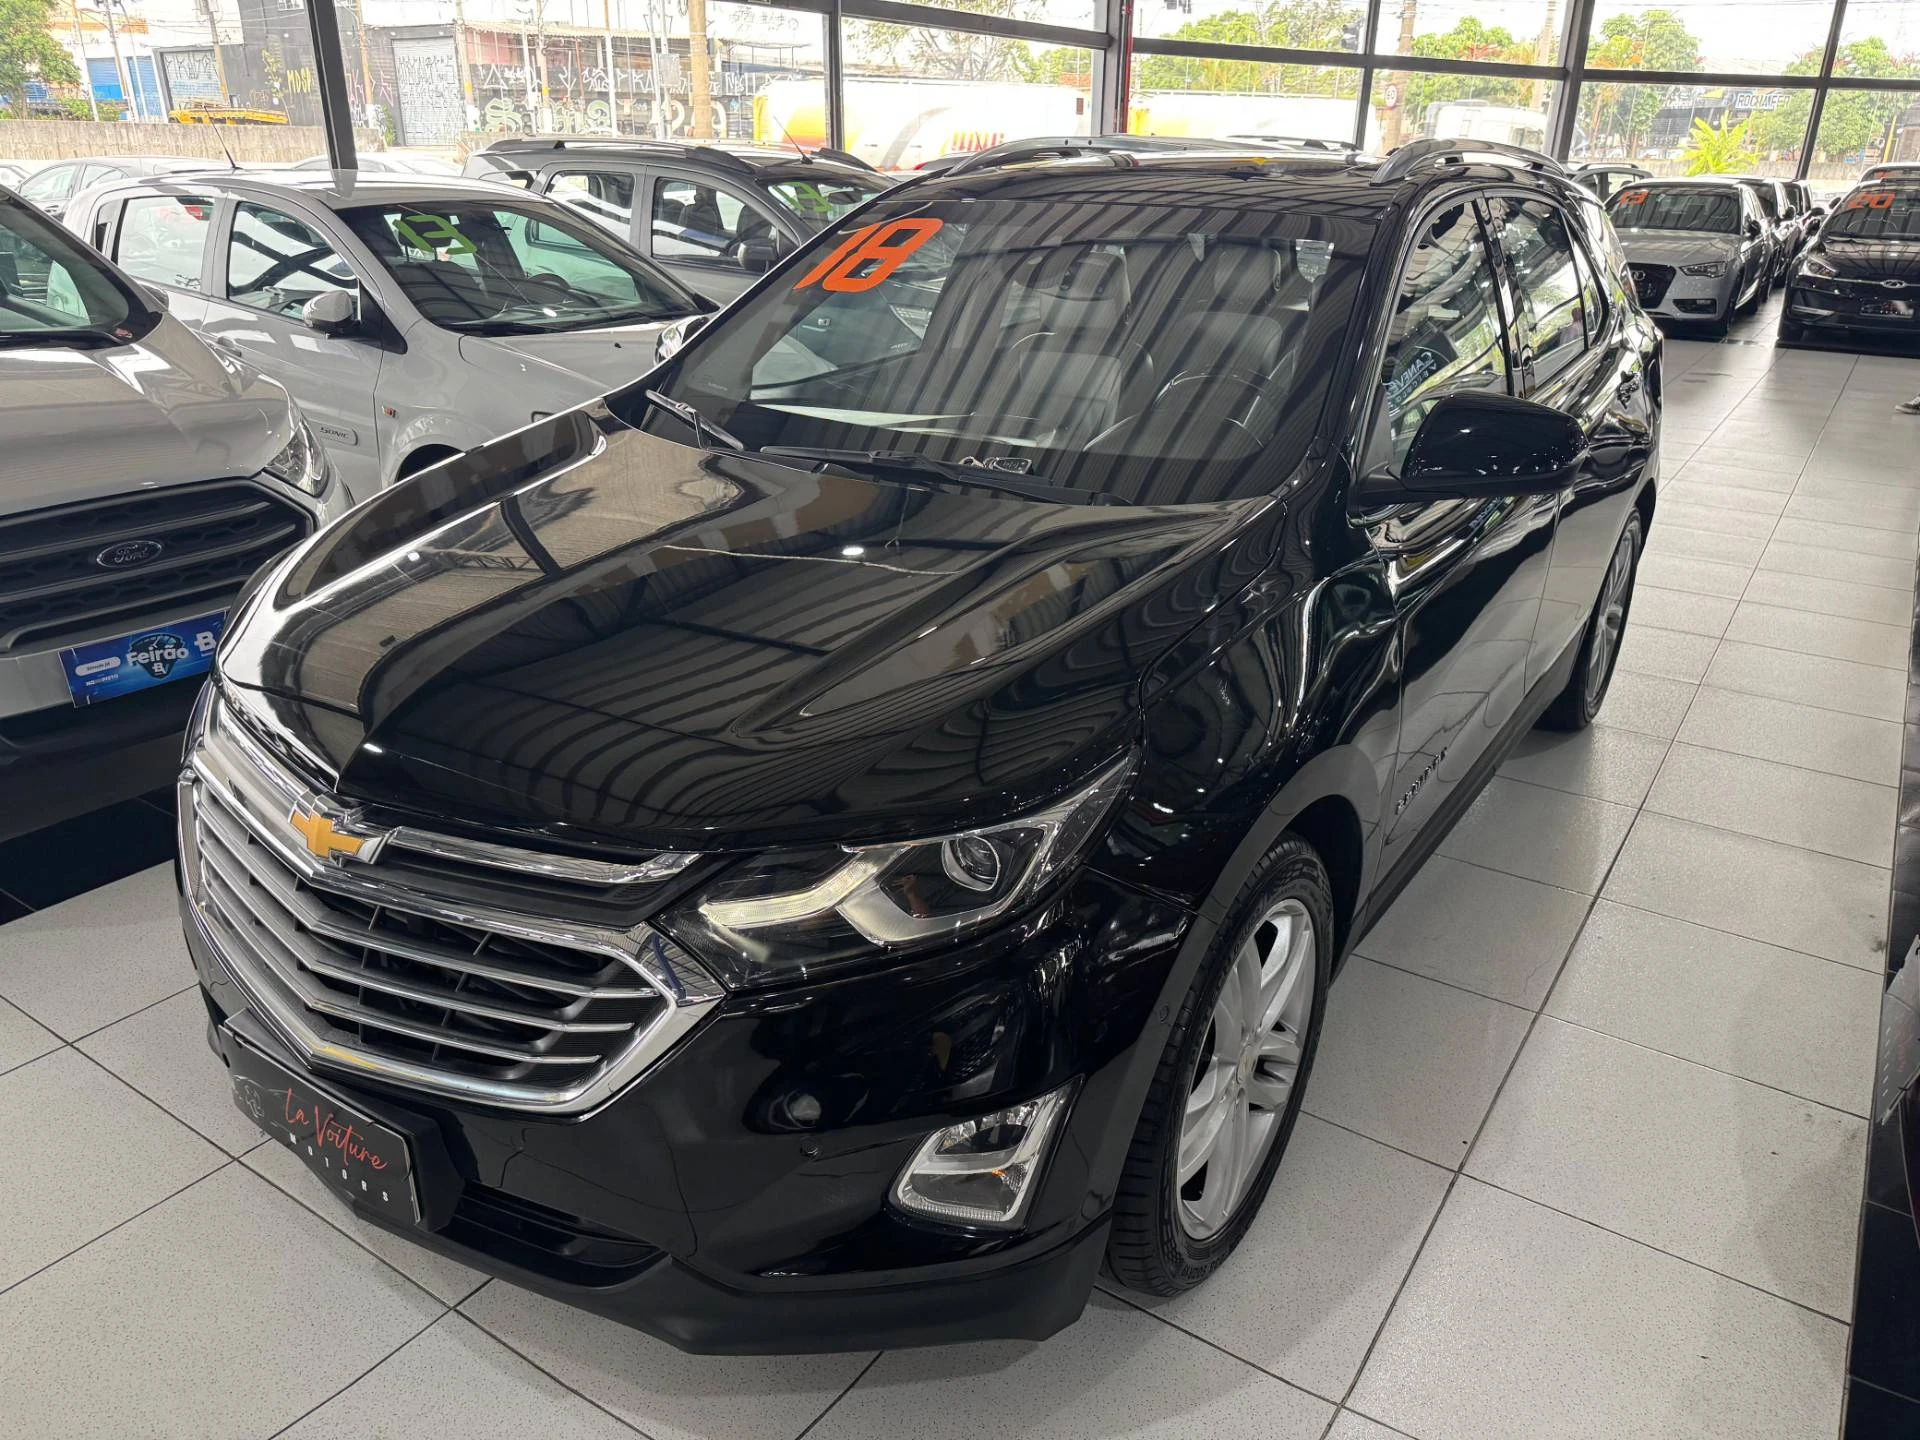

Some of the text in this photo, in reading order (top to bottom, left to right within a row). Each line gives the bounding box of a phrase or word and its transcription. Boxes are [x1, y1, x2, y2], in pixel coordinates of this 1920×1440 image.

[792, 217, 944, 293] 18
[125, 643, 190, 668] Feirão
[314, 1104, 388, 1171] Voiture
